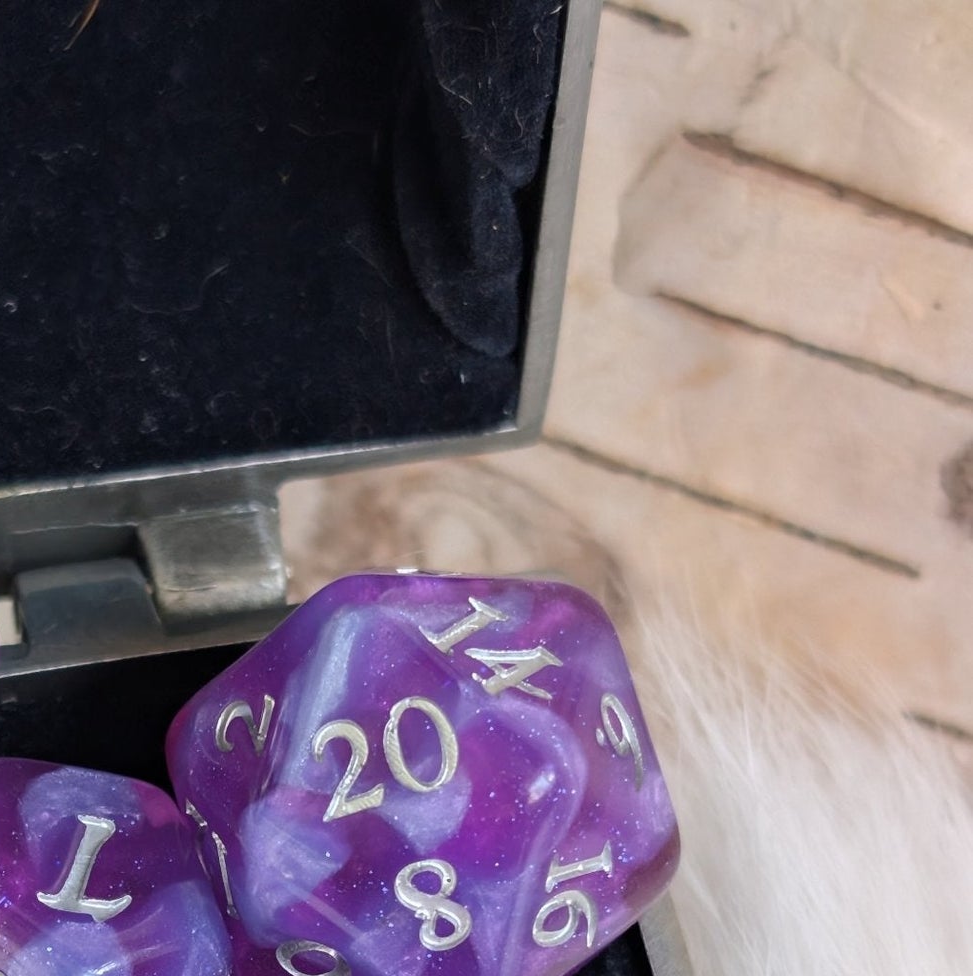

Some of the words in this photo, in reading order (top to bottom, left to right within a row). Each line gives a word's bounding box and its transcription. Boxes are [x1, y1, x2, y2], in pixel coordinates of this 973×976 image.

[419, 597, 563, 699] 14
[215, 694, 276, 756] 2
[312, 696, 459, 822] 20
[394, 859, 472, 951] 8
[532, 841, 613, 948] 16
